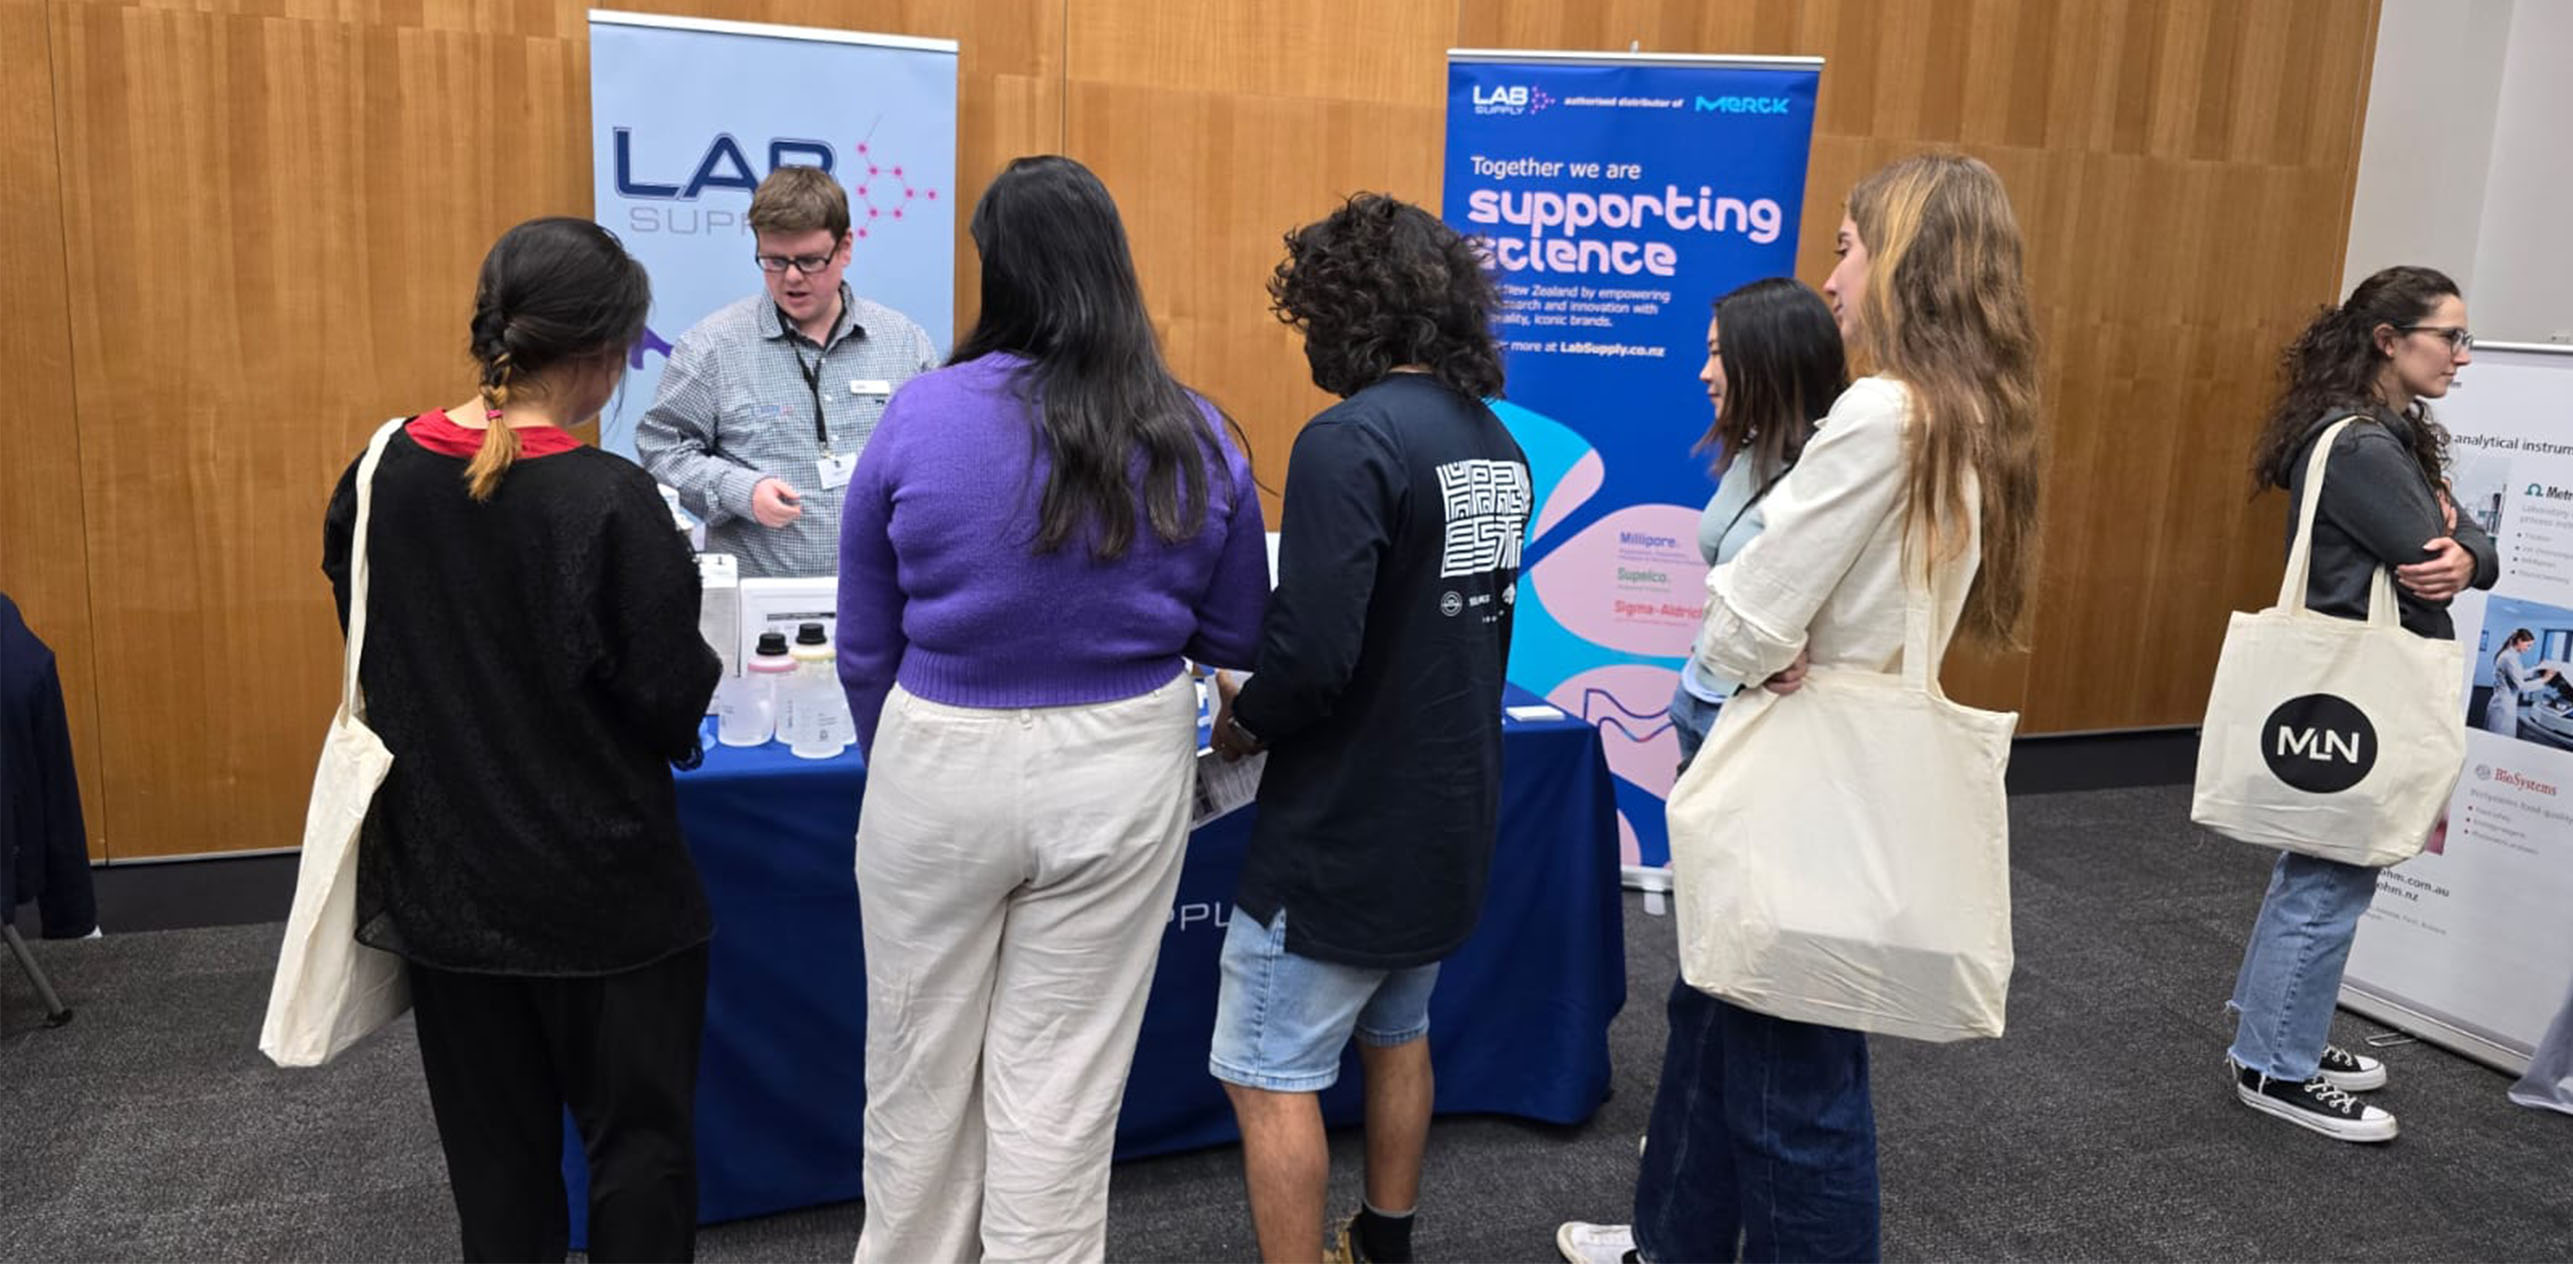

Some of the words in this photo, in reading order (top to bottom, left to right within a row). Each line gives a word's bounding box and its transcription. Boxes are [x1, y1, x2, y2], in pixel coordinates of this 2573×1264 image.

[1473, 85, 1529, 105] LAB
[1672, 98, 1684, 109] of
[1474, 105, 1526, 116] SUPPLY
[1470, 156, 1564, 180] Together
[1569, 162, 1601, 178] we
[1606, 163, 1642, 179] are
[1468, 185, 1782, 244] supporting
[1532, 285, 1578, 298] Zealand
[1581, 286, 1596, 300] by
[1598, 288, 1672, 304] empowering
[1544, 300, 1567, 312] and
[1569, 301, 1630, 314] innovation
[1633, 303, 1659, 315] with
[1534, 314, 1568, 326] iconic
[1570, 315, 1613, 328] brands.
[1510, 341, 1542, 352] more
[1545, 342, 1558, 353] at
[1560, 341, 1666, 358] LabSupply.co.nz
[2454, 434, 2519, 450] analytical
[1620, 531, 1677, 548] Millipore
[2277, 725, 2360, 764] MLN
[2494, 768, 2558, 796] BioSystems
